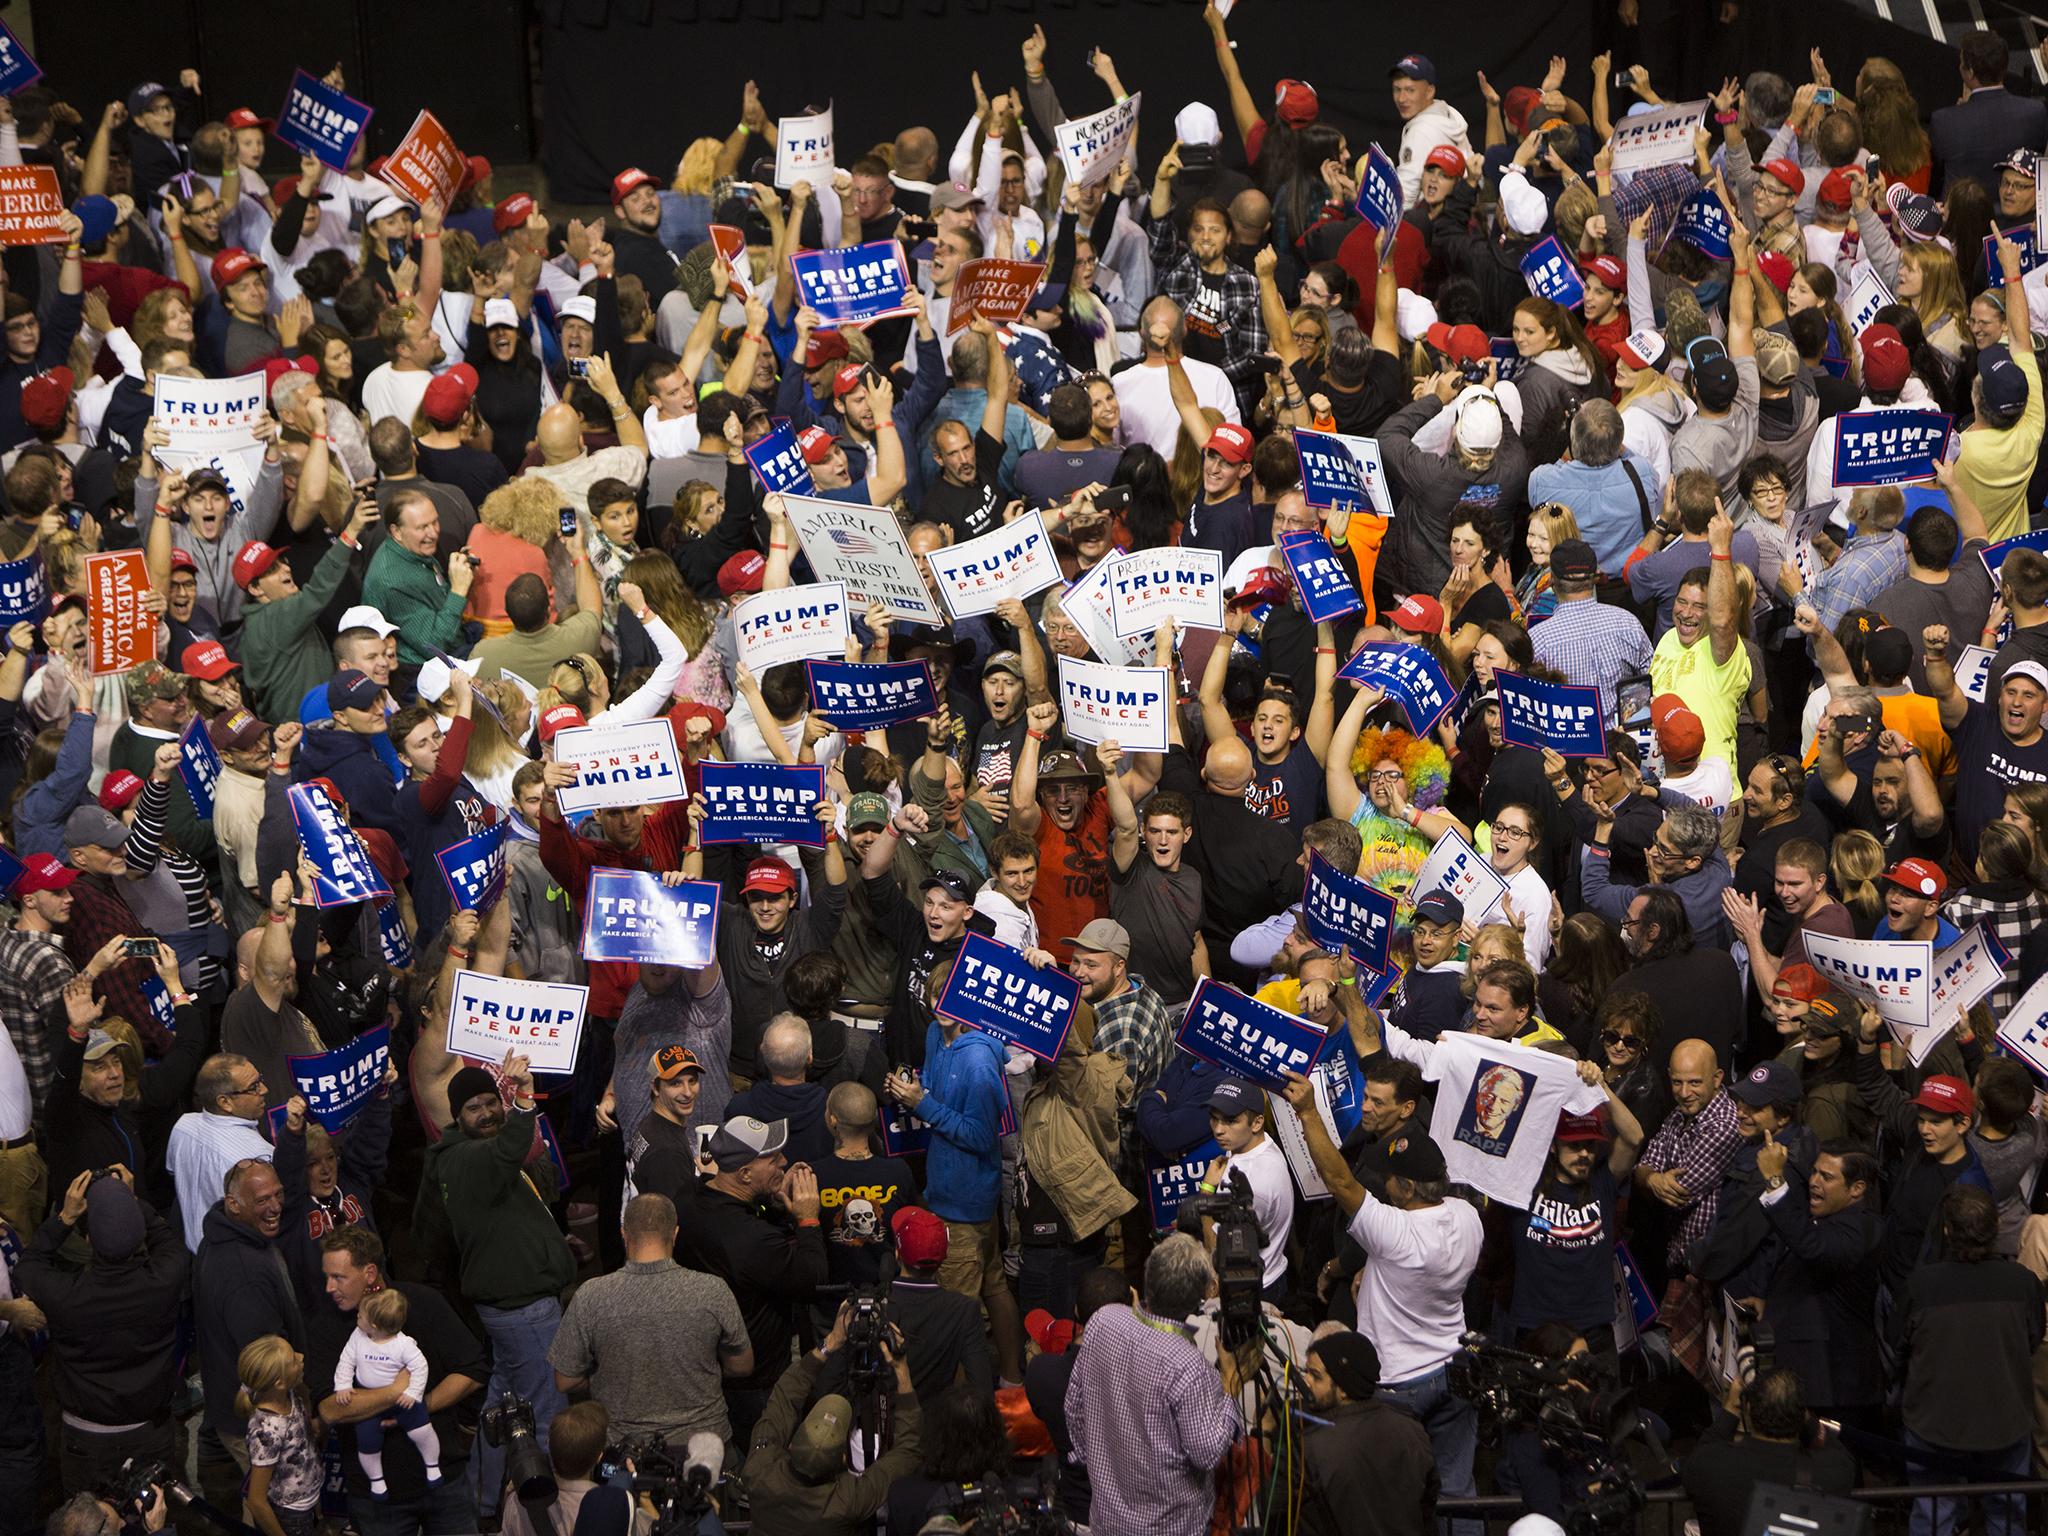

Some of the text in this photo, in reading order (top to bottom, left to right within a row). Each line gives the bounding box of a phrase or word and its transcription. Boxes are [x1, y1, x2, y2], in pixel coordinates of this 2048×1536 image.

[292, 88, 360, 134] TRUMP
[290, 106, 346, 144] PENCE
[1070, 115, 1134, 157] TRUMP
[1076, 112, 1117, 141] NURSES
[1618, 115, 1698, 139] TRUMP
[788, 138, 830, 152] TRU
[1619, 128, 1688, 147] PENCE
[794, 152, 833, 163] PEN
[1, 178, 36, 189] MAKE
[0, 192, 63, 213] ERICA
[0, 219, 20, 230] EAT
[802, 259, 899, 288] TRUMP
[977, 268, 1010, 279] MAKE
[1530, 256, 1562, 290] UMP
[815, 275, 894, 297] PENCE
[977, 299, 1019, 311] AGAIN
[1852, 294, 1881, 337] UMP
[164, 397, 259, 415] TRUMP
[170, 415, 251, 427] PENCE
[1843, 428, 1943, 449] TRUMP
[1851, 442, 1929, 459] PENCE
[761, 442, 802, 477] TRU
[1302, 452, 1356, 475] TRUM
[1865, 457, 1890, 466] AMERICA
[1892, 454, 1909, 463] GREAT
[777, 459, 807, 486] PEN
[210, 456, 244, 515] UMP
[835, 557, 901, 580] FIRST!
[944, 534, 1039, 581] TRUMP
[1297, 557, 1344, 580] TRU
[957, 553, 1035, 590] PENCE
[1116, 570, 1215, 594] TRUMP
[884, 583, 921, 598] PENCE
[1126, 586, 1205, 605] PENCE
[1315, 590, 1332, 599] MAKE
[100, 566, 115, 665] GREAT AGAIN
[112, 557, 133, 669] AMERICA
[740, 603, 839, 635] TRUMP
[748, 619, 830, 644] PENCE
[817, 677, 924, 697] TRUMP
[1362, 659, 1431, 708] PENCE
[1363, 651, 1443, 707] TRUMP
[827, 691, 917, 707] PENCE
[1066, 681, 1159, 706] TRUMP
[1503, 689, 1595, 720] TRUMP
[876, 705, 897, 713] GREAT
[1074, 700, 1148, 719] PENCE
[1512, 707, 1586, 731] PENCE
[571, 751, 659, 771] PENCE
[705, 786, 816, 803] TRUMP
[1270, 794, 1289, 816] 16
[716, 803, 807, 815] PENCE
[312, 788, 356, 898] TRUMP
[1377, 844, 1398, 855] Lake
[597, 897, 711, 919] TRUMP
[1311, 873, 1386, 929] TRUMP
[1311, 898, 1375, 940] PENCE
[1317, 914, 1338, 931] AMERICA
[1340, 926, 1358, 940] GREAT
[1814, 953, 1922, 982] TRUMP
[1931, 943, 1978, 993] UMP
[964, 955, 1069, 1012] TRUMP
[1827, 970, 1910, 995] PENCE
[1936, 962, 1975, 1000] NCE
[463, 995, 574, 1024] TRUMP
[958, 989, 977, 1002] MAKE
[977, 997, 1006, 1014] AMERICA
[1007, 1009, 1028, 1023] GREAT
[1029, 1020, 1052, 1034] AGAIN!
[965, 977, 1054, 1023] PENCE
[464, 1028, 482, 1037] MAKE
[484, 1033, 513, 1043] AMERICA
[469, 1015, 560, 1037] PENCE
[987, 1029, 1006, 1041] 2016
[1203, 1000, 1309, 1065] TRUMP
[1196, 1028, 1214, 1042] MAKE
[1215, 1040, 1243, 1059] AMERICA
[1243, 1056, 1264, 1071] GREAT
[1203, 1020, 1290, 1074] PENCE
[297, 1045, 389, 1093] TRUMP
[309, 1066, 382, 1104] PENCE
[327, 1101, 352, 1113] AMERICA
[1458, 1128, 1507, 1155] RAPE
[1152, 1161, 1205, 1184] TRU
[1533, 1194, 1602, 1228] Hillary
[1526, 1227, 1587, 1248] for Prison
